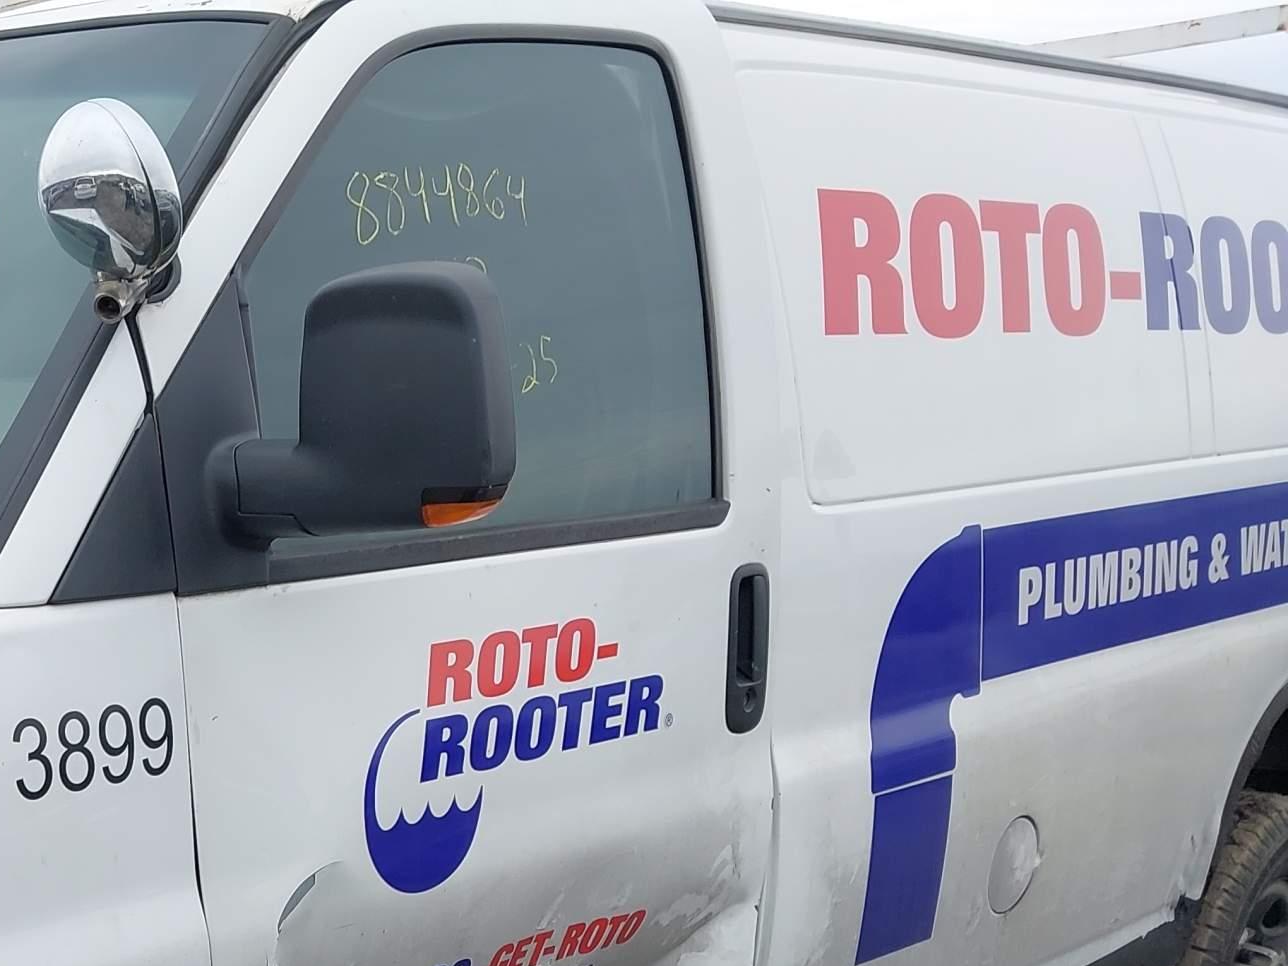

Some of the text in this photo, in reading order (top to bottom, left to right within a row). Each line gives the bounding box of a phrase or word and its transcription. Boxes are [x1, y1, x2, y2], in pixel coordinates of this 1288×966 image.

[346, 162, 528, 245] 8844864
[1017, 535, 1199, 627] PLUMBING
[1207, 532, 1230, 584] &
[426, 617, 619, 708] ROTO-
[12, 697, 173, 800] 3899
